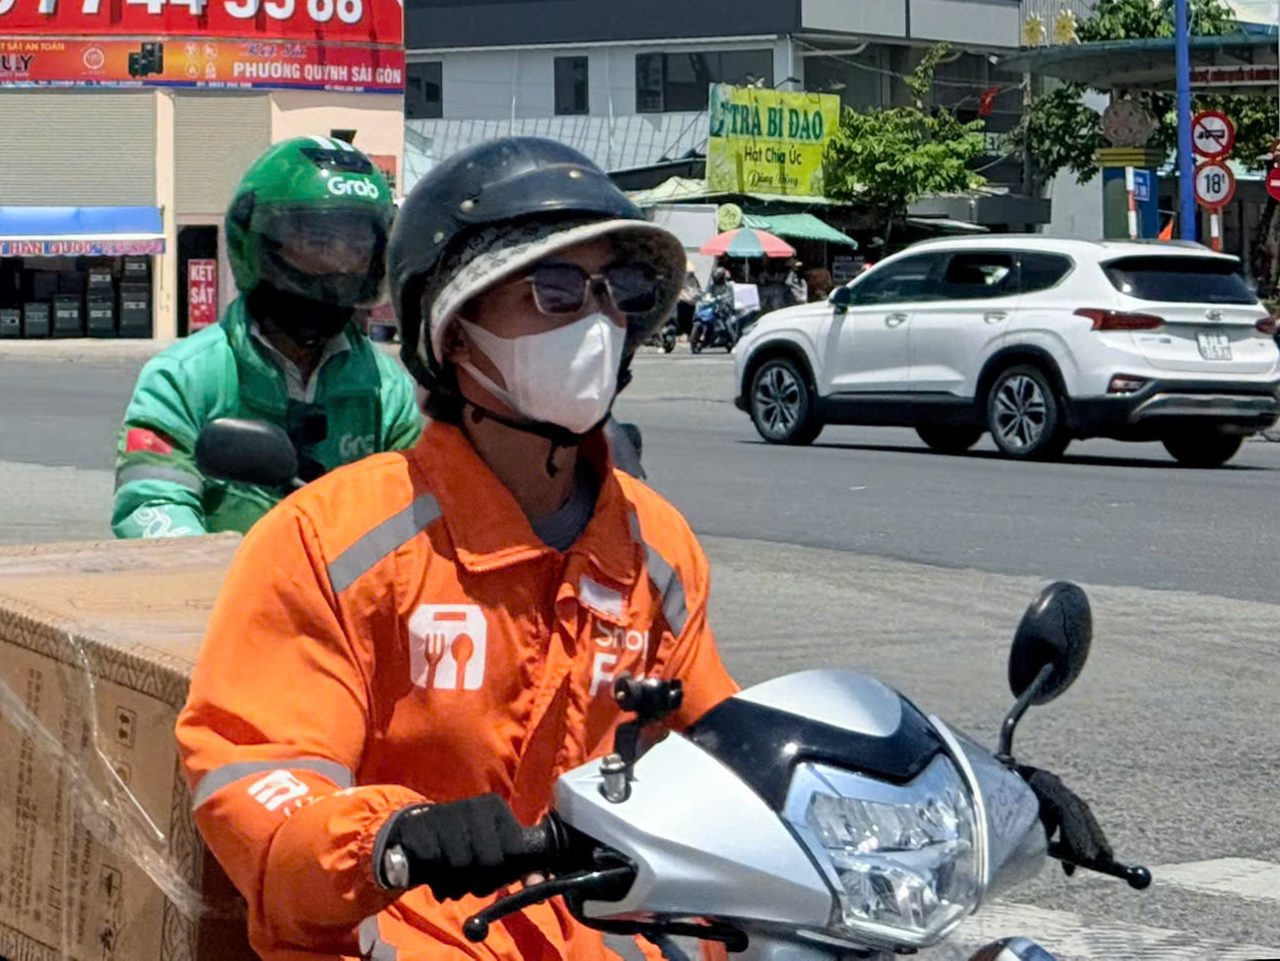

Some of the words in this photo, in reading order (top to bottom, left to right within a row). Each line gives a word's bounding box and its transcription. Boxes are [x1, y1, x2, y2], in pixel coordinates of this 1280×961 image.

[233, 60, 300, 79] PHƯƠNG
[730, 96, 762, 136] TRÀ
[767, 99, 784, 138] BÍ
[788, 108, 823, 140] ĐAO
[745, 145, 763, 165] Hạt
[765, 146, 786, 164] Chia
[789, 145, 802, 165] Úc
[328, 176, 379, 199] Grab
